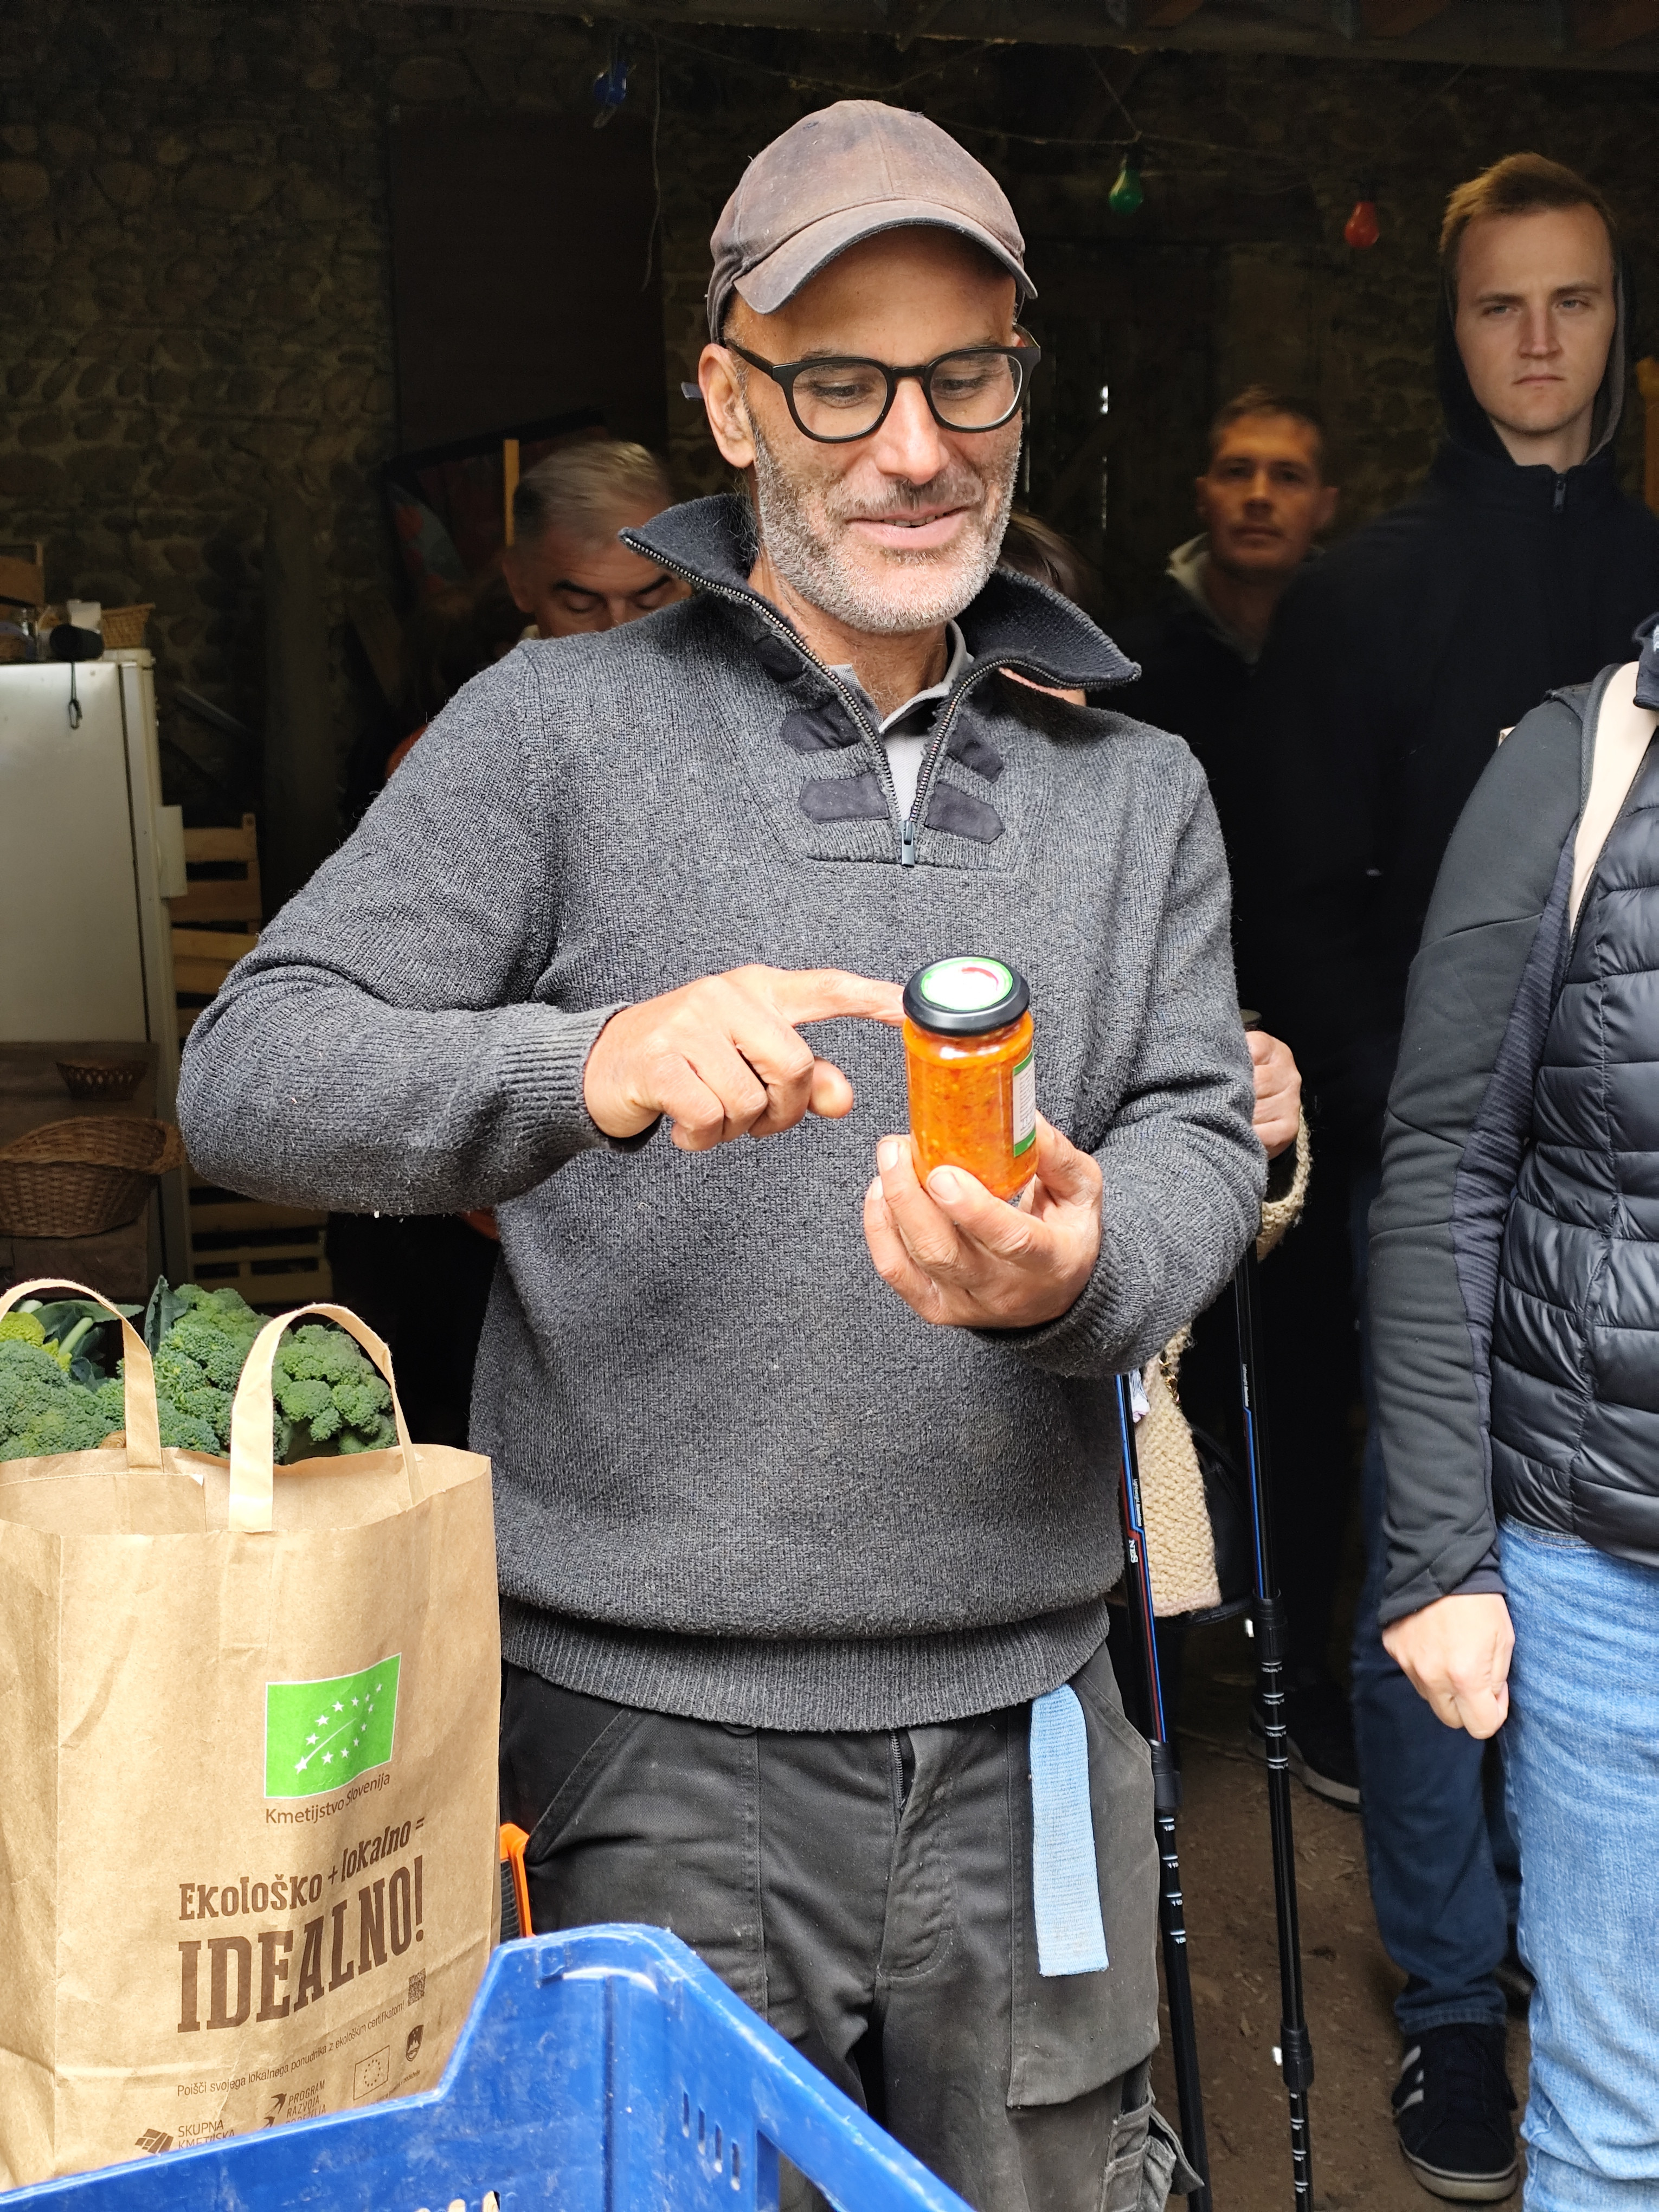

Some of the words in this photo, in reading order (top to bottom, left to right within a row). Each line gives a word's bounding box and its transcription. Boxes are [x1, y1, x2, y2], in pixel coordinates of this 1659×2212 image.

[266, 1796, 344, 1823] Kmetijstvo
[346, 1773, 390, 1806] Slovenija
[178, 1855, 423, 2033] IDEALNO!
[178, 2082, 207, 2097] Poišči
[210, 2078, 246, 2092] svojega
[248, 2064, 288, 2084] lokalnega
[291, 2045, 327, 2073] ponudnika
[329, 2043, 333, 2052] z
[336, 2024, 366, 2049] ekološkim
[368, 2000, 404, 2030] certifikatom!
[286, 2095, 319, 2118] RAZVOJA
[288, 2079, 325, 2106] PROGRAM
[178, 2119, 224, 2137] SKUPNA
